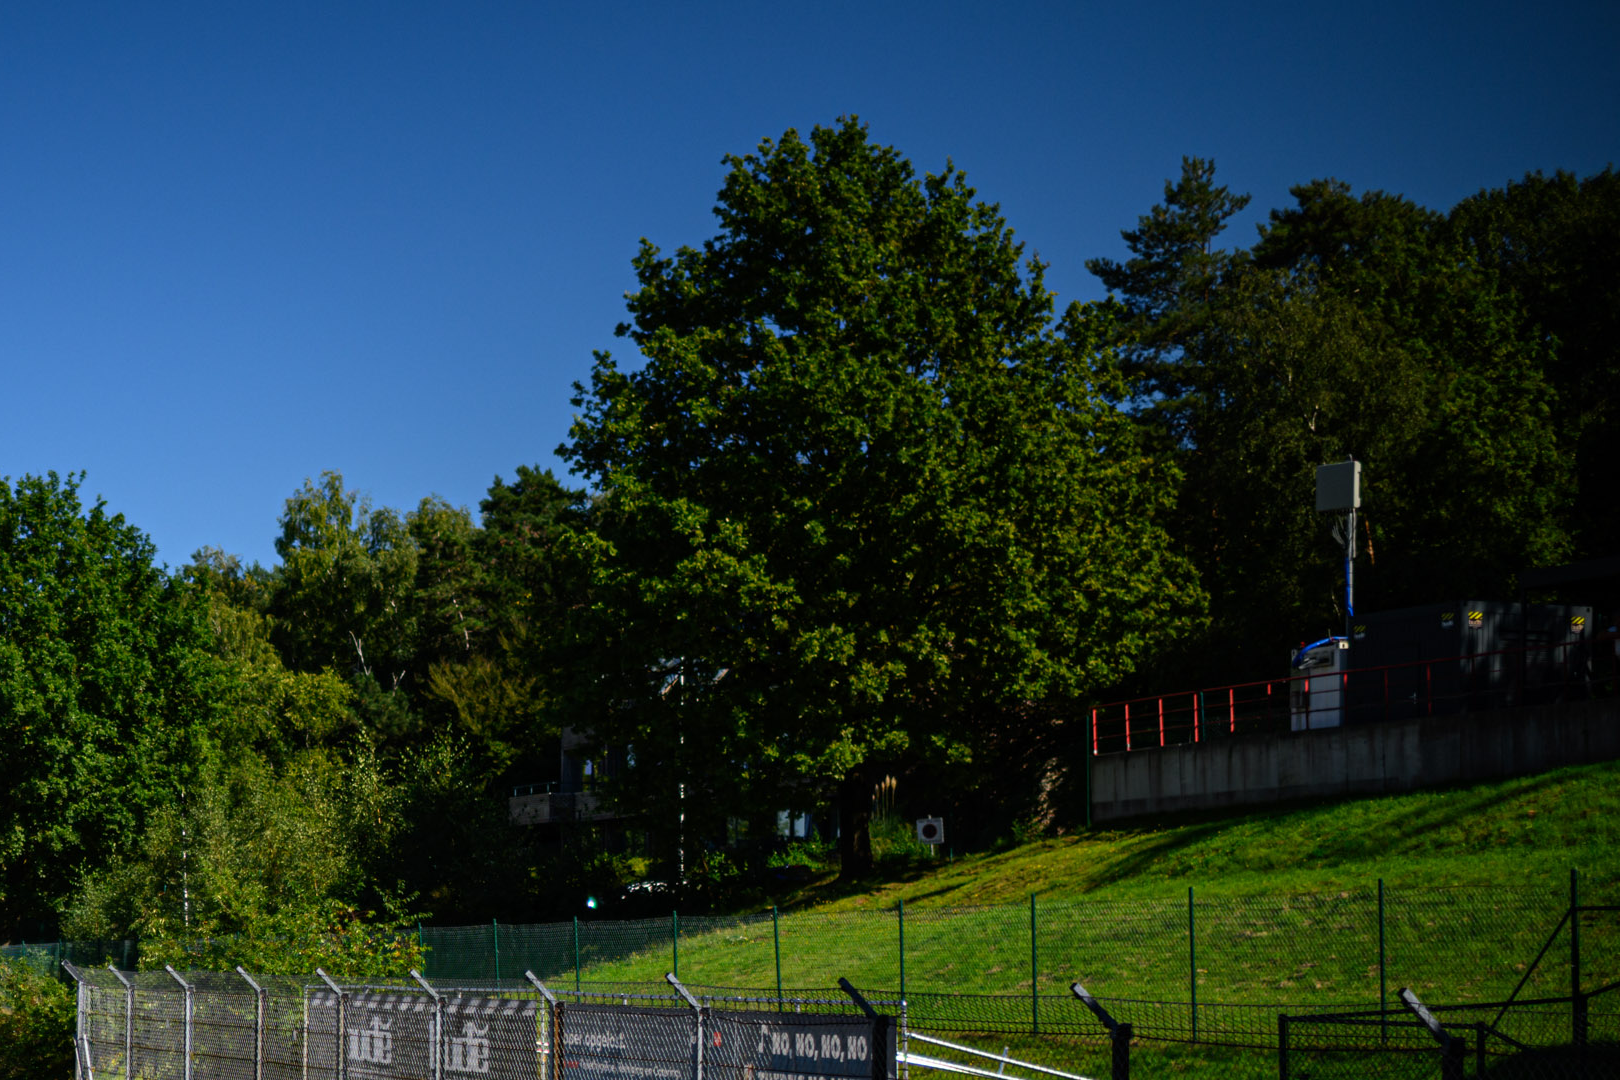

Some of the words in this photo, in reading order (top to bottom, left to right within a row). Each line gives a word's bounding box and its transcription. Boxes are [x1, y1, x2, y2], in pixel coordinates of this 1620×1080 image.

[772, 1032, 792, 1059] NO,
[795, 1033, 819, 1061] NO,
[821, 1034, 845, 1063] NO,
